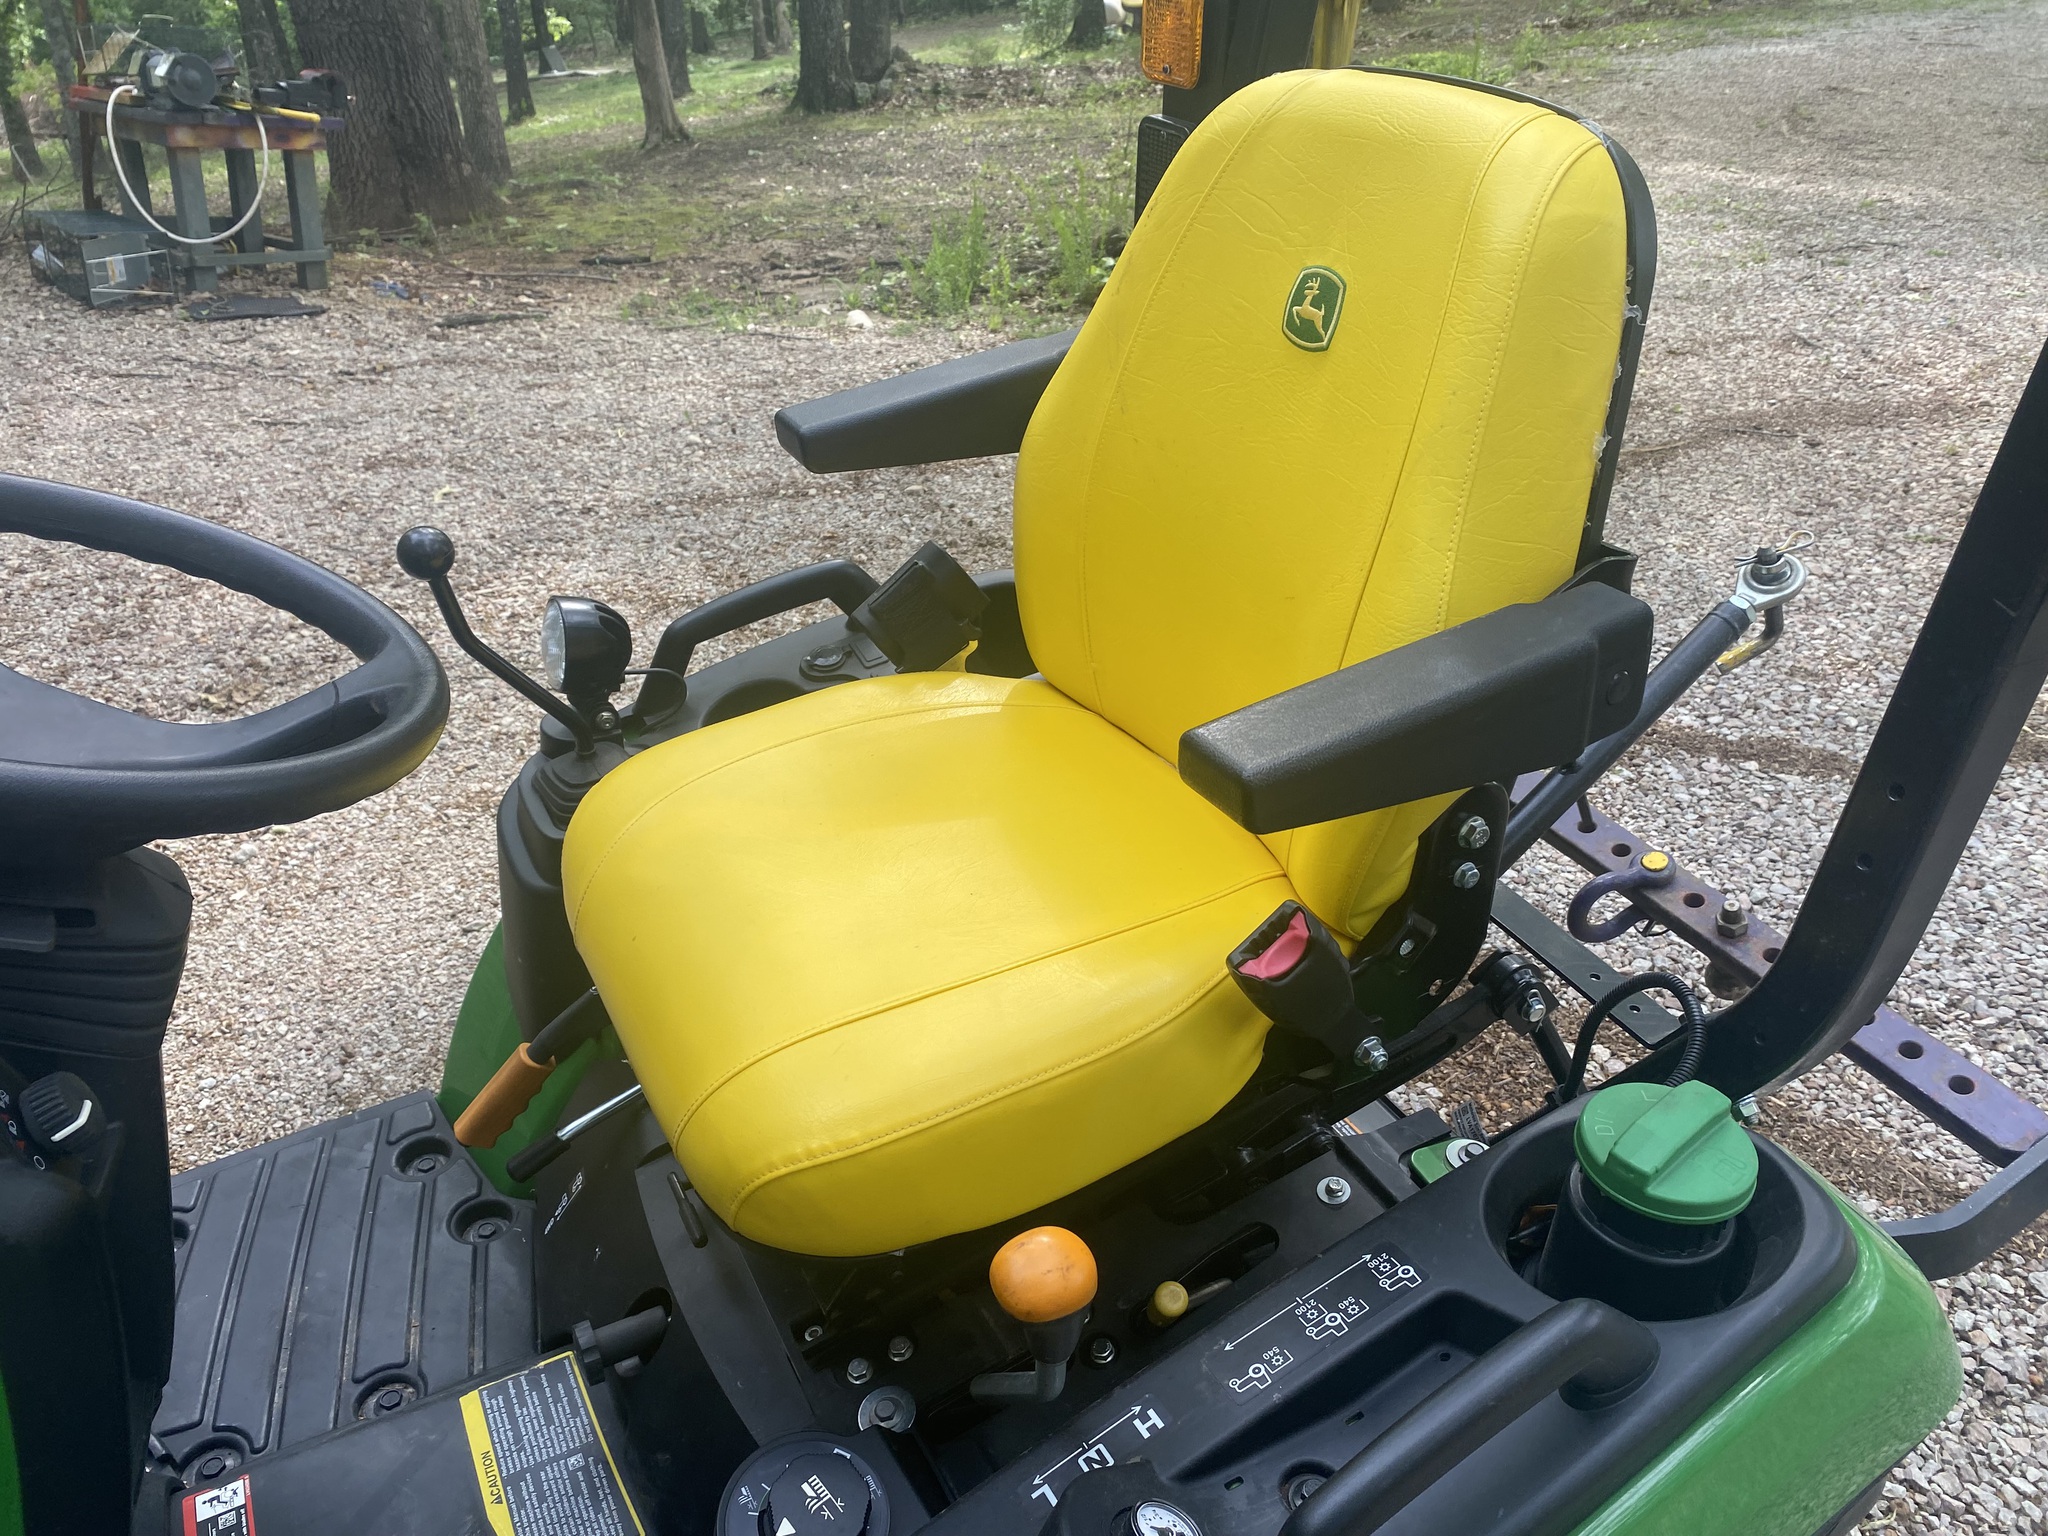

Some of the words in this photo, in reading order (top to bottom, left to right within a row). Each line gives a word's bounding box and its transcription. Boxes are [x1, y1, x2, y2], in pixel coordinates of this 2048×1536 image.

[1367, 1252, 1389, 1269] 2100
[1294, 1299, 1317, 1316] 2100
[1338, 1296, 1356, 1310] 540
[1262, 1346, 1280, 1360] 540
[507, 1379, 517, 1397] highway
[519, 1374, 529, 1390] ground
[540, 1373, 548, 1387] before
[568, 1373, 576, 1388] unless
[531, 1391, 539, 1405] before
[544, 1386, 552, 1397] stop
[556, 1382, 565, 1397] tractor
[572, 1388, 582, 1407] machine
[481, 1389, 491, 1408] applying
[490, 1397, 499, 1411] rough
[525, 1394, 537, 1418] implement
[561, 1396, 572, 1414] leaving
[514, 1403, 522, 1416] lights
[535, 1404, 546, 1425] securely
[548, 1402, 559, 1426] movement
[579, 1406, 589, 1425] operate
[487, 1413, 496, 1430] turning
[494, 1411, 502, 1427] around
[501, 1412, 511, 1429] ground
[517, 1416, 527, 1435] warning
[1132, 1408, 1165, 1439] H
[498, 1427, 509, 1450] operating
[506, 1429, 515, 1444] rough
[525, 1421, 537, 1446] prohibited
[541, 1425, 549, 1439] brake
[563, 1426, 575, 1448] servicing
[570, 1426, 581, 1446] Remove
[587, 1433, 593, 1441] Do
[494, 1442, 503, 1458] speed
[522, 1434, 532, 1455] flashing
[511, 1451, 521, 1471] hazards
[533, 1446, 541, 1462] unless
[541, 1447, 549, 1460] Stop
[498, 1457, 507, 1476] Reduce
[505, 1456, 514, 1473] brakes
[552, 1462, 560, 1478] others
[558, 1459, 569, 1479] starting
[587, 1456, 599, 1477] clothing
[481, 1450, 502, 1497] CAUTION
[525, 1472, 534, 1492] devices
[506, 1485, 514, 1502] before
[519, 1480, 529, 1500] without
[549, 1479, 560, 1502] rearward
[556, 1478, 565, 1494] and/or
[564, 1479, 573, 1496] before
[580, 1480, 589, 1498] tractor
[601, 1477, 610, 1493] driven
[530, 1491, 540, 1508] safety
[546, 1495, 555, 1508] only
[607, 1493, 616, 1509] power
[1030, 1483, 1058, 1507] L
[510, 1502, 519, 1522] Manual
[525, 1499, 535, 1522] machine
[556, 1502, 564, 1517] avoid
[561, 1494, 571, 1516] children
[569, 1495, 580, 1518] machine
[587, 1506, 596, 1521] riders
[550, 1508, 558, 1523] loads
[568, 1516, 577, 1535] certain
[616, 1522, 625, 1536] away
